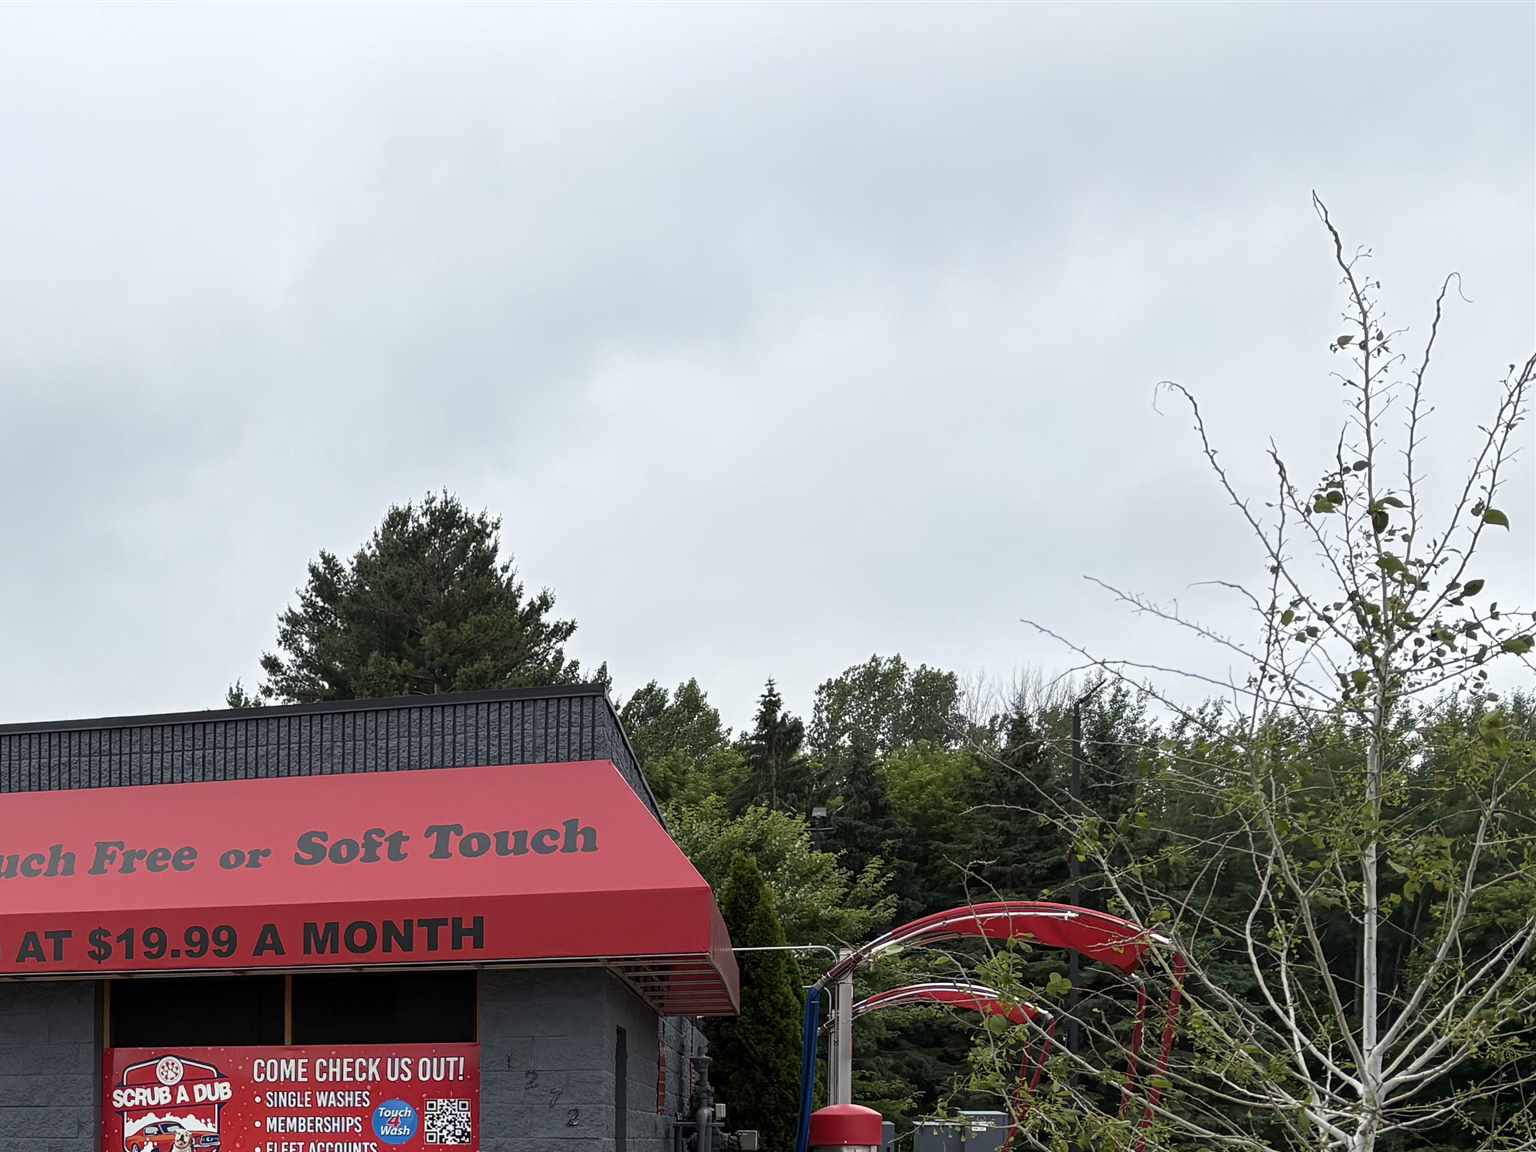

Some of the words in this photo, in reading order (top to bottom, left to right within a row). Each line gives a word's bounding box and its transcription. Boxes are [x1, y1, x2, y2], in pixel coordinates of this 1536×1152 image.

[87, 840, 198, 875] Free
[218, 847, 272, 871] or
[293, 827, 410, 866] Soft
[423, 818, 599, 860] Touch
[15, 929, 73, 963] AT
[87, 924, 238, 964] $19.99
[252, 923, 286, 957] A
[302, 915, 485, 955] MONTH
[252, 1057, 309, 1083] COME
[315, 1057, 381, 1082] CHECK
[386, 1057, 412, 1081] US
[417, 1056, 465, 1081] OUT!
[112, 1085, 172, 1109] SCRUB
[175, 1084, 193, 1105] A
[194, 1080, 232, 1103] DUB
[265, 1091, 312, 1108] SINGLE
[315, 1090, 370, 1107] WASHES
[378, 1107, 412, 1118] Touch
[386, 1116, 401, 1127] 4
[265, 1116, 363, 1134] MEMBERSHIPS
[380, 1125, 410, 1136] Wash
